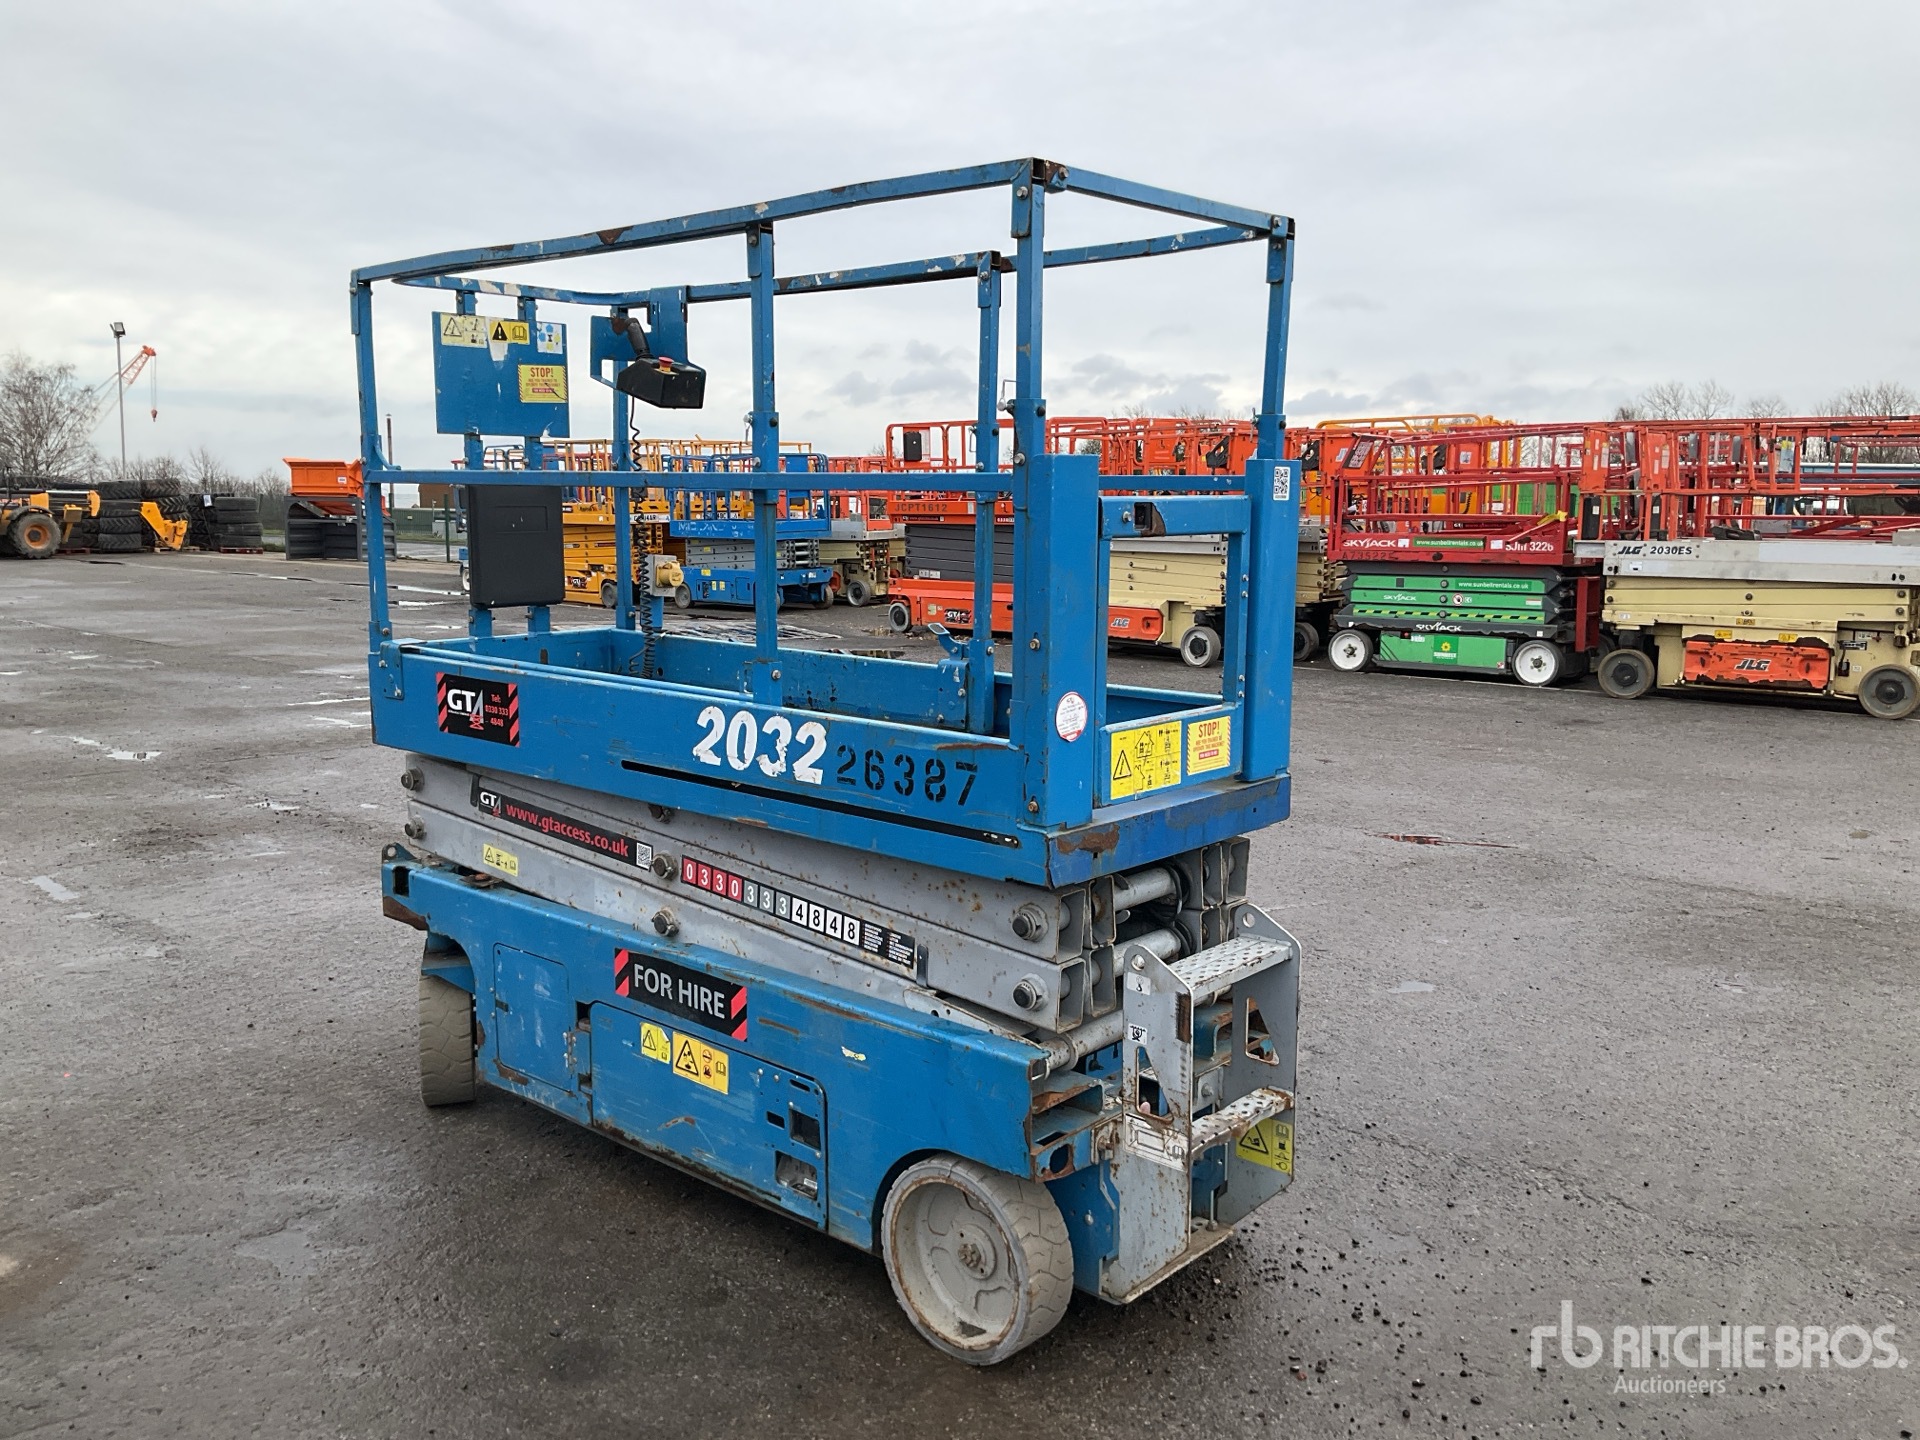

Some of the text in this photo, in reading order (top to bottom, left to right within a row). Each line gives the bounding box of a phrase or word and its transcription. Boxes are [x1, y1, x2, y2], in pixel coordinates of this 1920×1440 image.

[530, 367, 554, 378] STOP!
[895, 503, 948, 512] JCPT1612
[1342, 538, 1396, 548] SKYJACK
[1617, 546, 1692, 555] JLG 2030ES
[1383, 593, 1416, 601] SKYJACK
[1111, 618, 1130, 629] JLG
[1734, 658, 1771, 672] JLG
[485, 705, 509, 716] 0330 333
[490, 717, 504, 727] 4848
[1198, 721, 1220, 738] STOP!
[693, 706, 978, 806] 2032 26387
[505, 804, 629, 857] www.gtaccess.co.uk
[634, 964, 726, 1019] FOR HIRE
